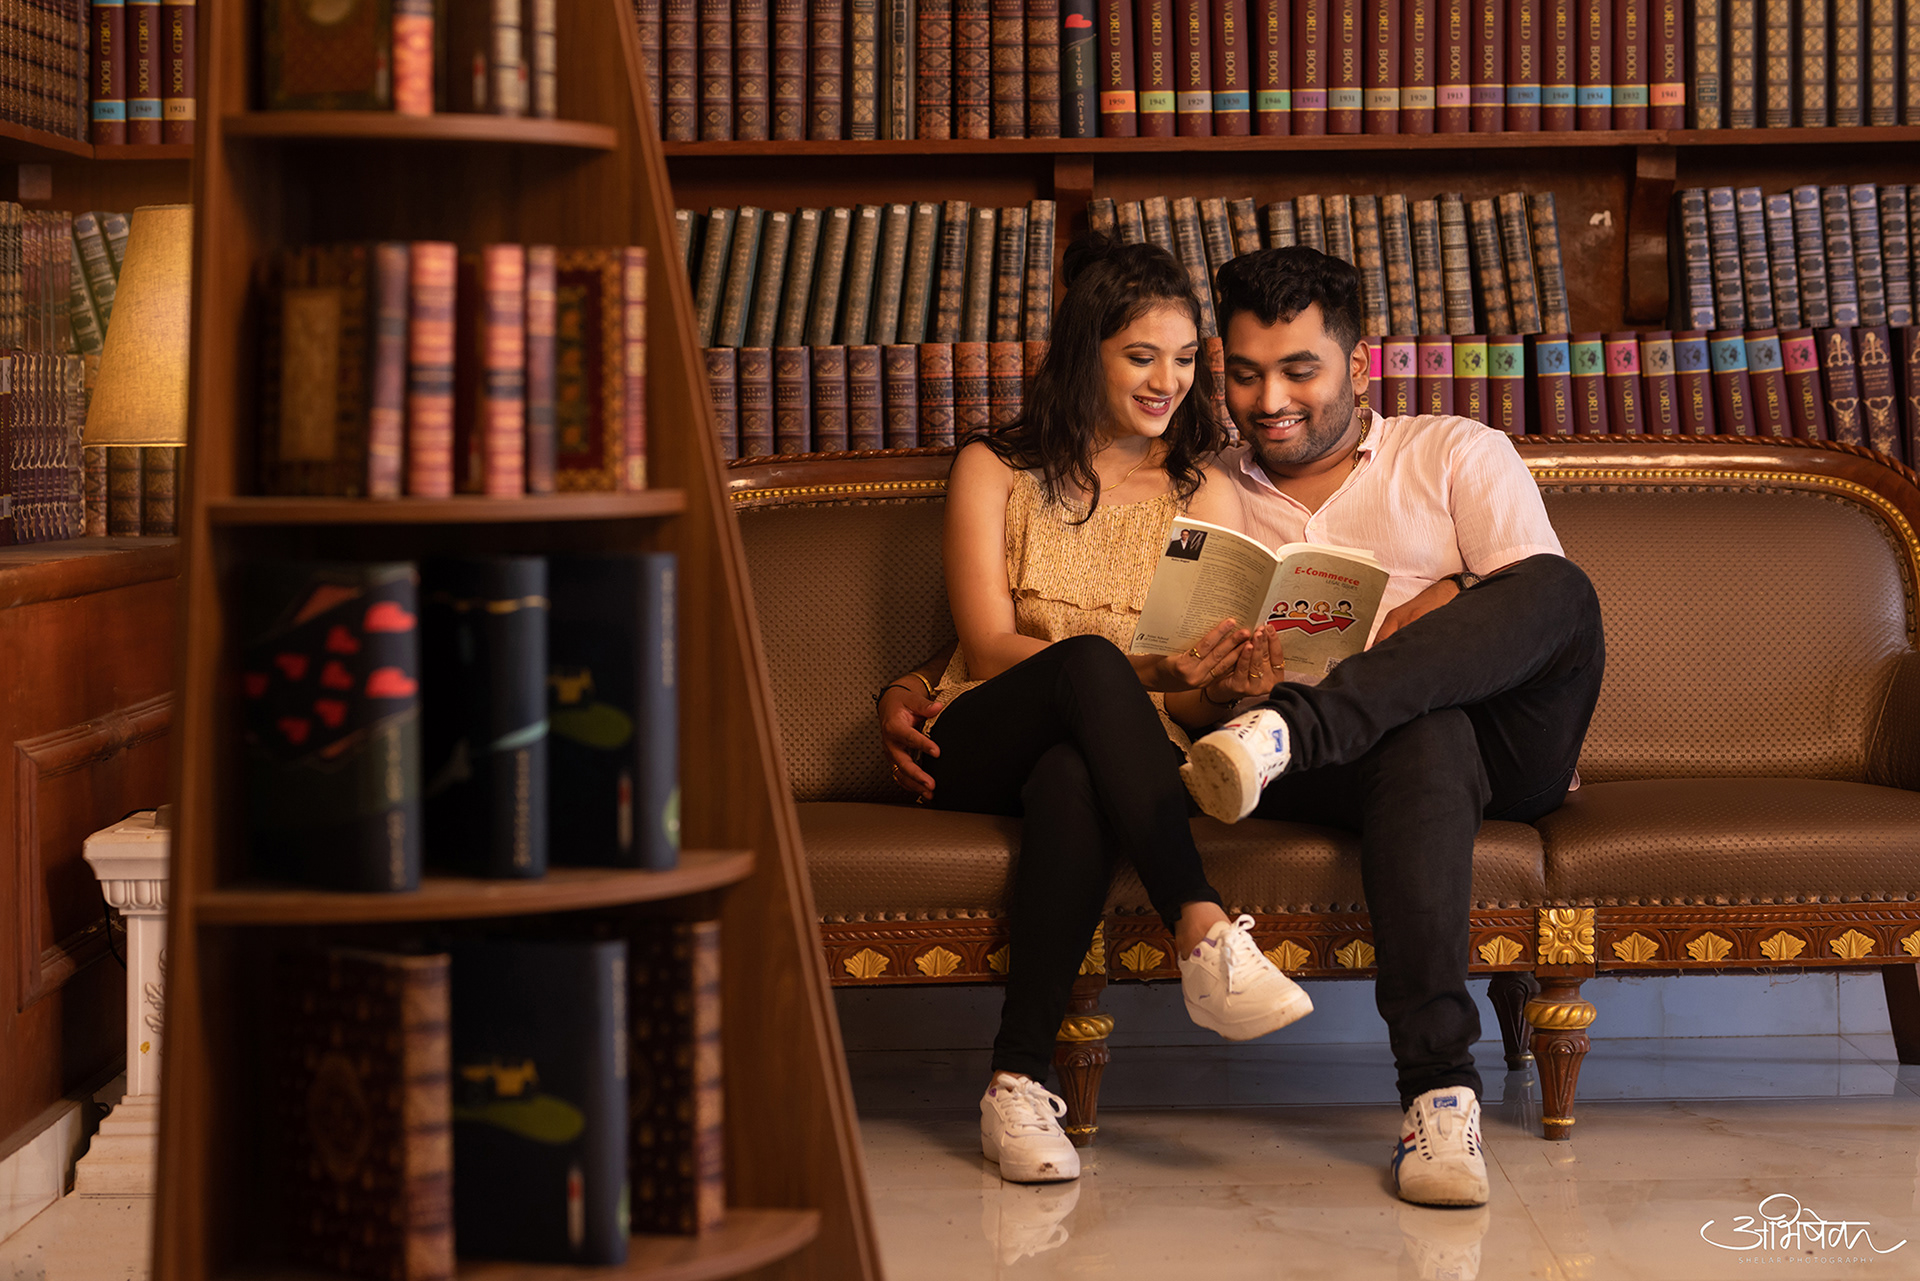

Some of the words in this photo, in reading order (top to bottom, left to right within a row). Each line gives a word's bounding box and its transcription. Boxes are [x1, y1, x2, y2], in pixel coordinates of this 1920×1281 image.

[101, 10, 111, 55] WORLD
[138, 9, 148, 53] WORLD
[172, 9, 183, 54] WORLD
[1109, 2, 1121, 47] WORLD
[1151, 1, 1163, 47] WORLD
[1189, 2, 1201, 47] WORLD
[1223, 1, 1235, 46] WORLD
[1267, 0, 1279, 45] WORLD
[1306, 0, 1317, 44] WORLD
[1342, 0, 1354, 44] WORLD
[1378, 0, 1390, 44] WORLD
[101, 60, 111, 95] BOOK
[138, 59, 149, 93] BOOK
[173, 59, 183, 93] BOOK
[1110, 52, 1122, 85] BOOK
[1152, 52, 1163, 85] BOOK
[1189, 52, 1201, 85] BOOK
[1224, 52, 1236, 85] BOOK
[1267, 51, 1279, 84] BOOK
[1305, 50, 1317, 83] BOOK
[1342, 49, 1354, 82] BOOK
[1377, 49, 1389, 83] BOOK
[1413, 48, 1425, 81] BOOK
[1449, 46, 1461, 80] BOOK
[1483, 45, 1495, 79] BOOK
[1520, 45, 1532, 79] BOOK
[1556, 46, 1567, 79] BOOK
[1589, 46, 1601, 80] BOOK
[1625, 46, 1637, 80] BOOK
[1664, 44, 1676, 78] BOOK
[169, 105, 186, 113] 1921
[1149, 97, 1166, 106] 1945
[1187, 97, 1204, 106] 1929
[1302, 95, 1318, 104] 1914
[1339, 94, 1355, 103] 1931
[1374, 95, 1391, 104] 1920
[1410, 93, 1427, 102] 1920
[1661, 89, 1677, 99] 1941
[1397, 381, 1407, 416] WORL
[1431, 381, 1442, 416] WORL
[1469, 382, 1480, 421] WORL
[1502, 382, 1512, 426] WORLD
[1554, 379, 1566, 424] WORLD
[1587, 380, 1599, 424] WORLD
[1623, 379, 1635, 423] WORLD
[1659, 379, 1671, 423] WORLD
[1692, 377, 1704, 421] WORLD
[1731, 375, 1744, 420] WORLD
[1766, 375, 1780, 420] WORLD
[1802, 375, 1815, 420] WORLD
[1294, 566, 1360, 586] E-Commerce
